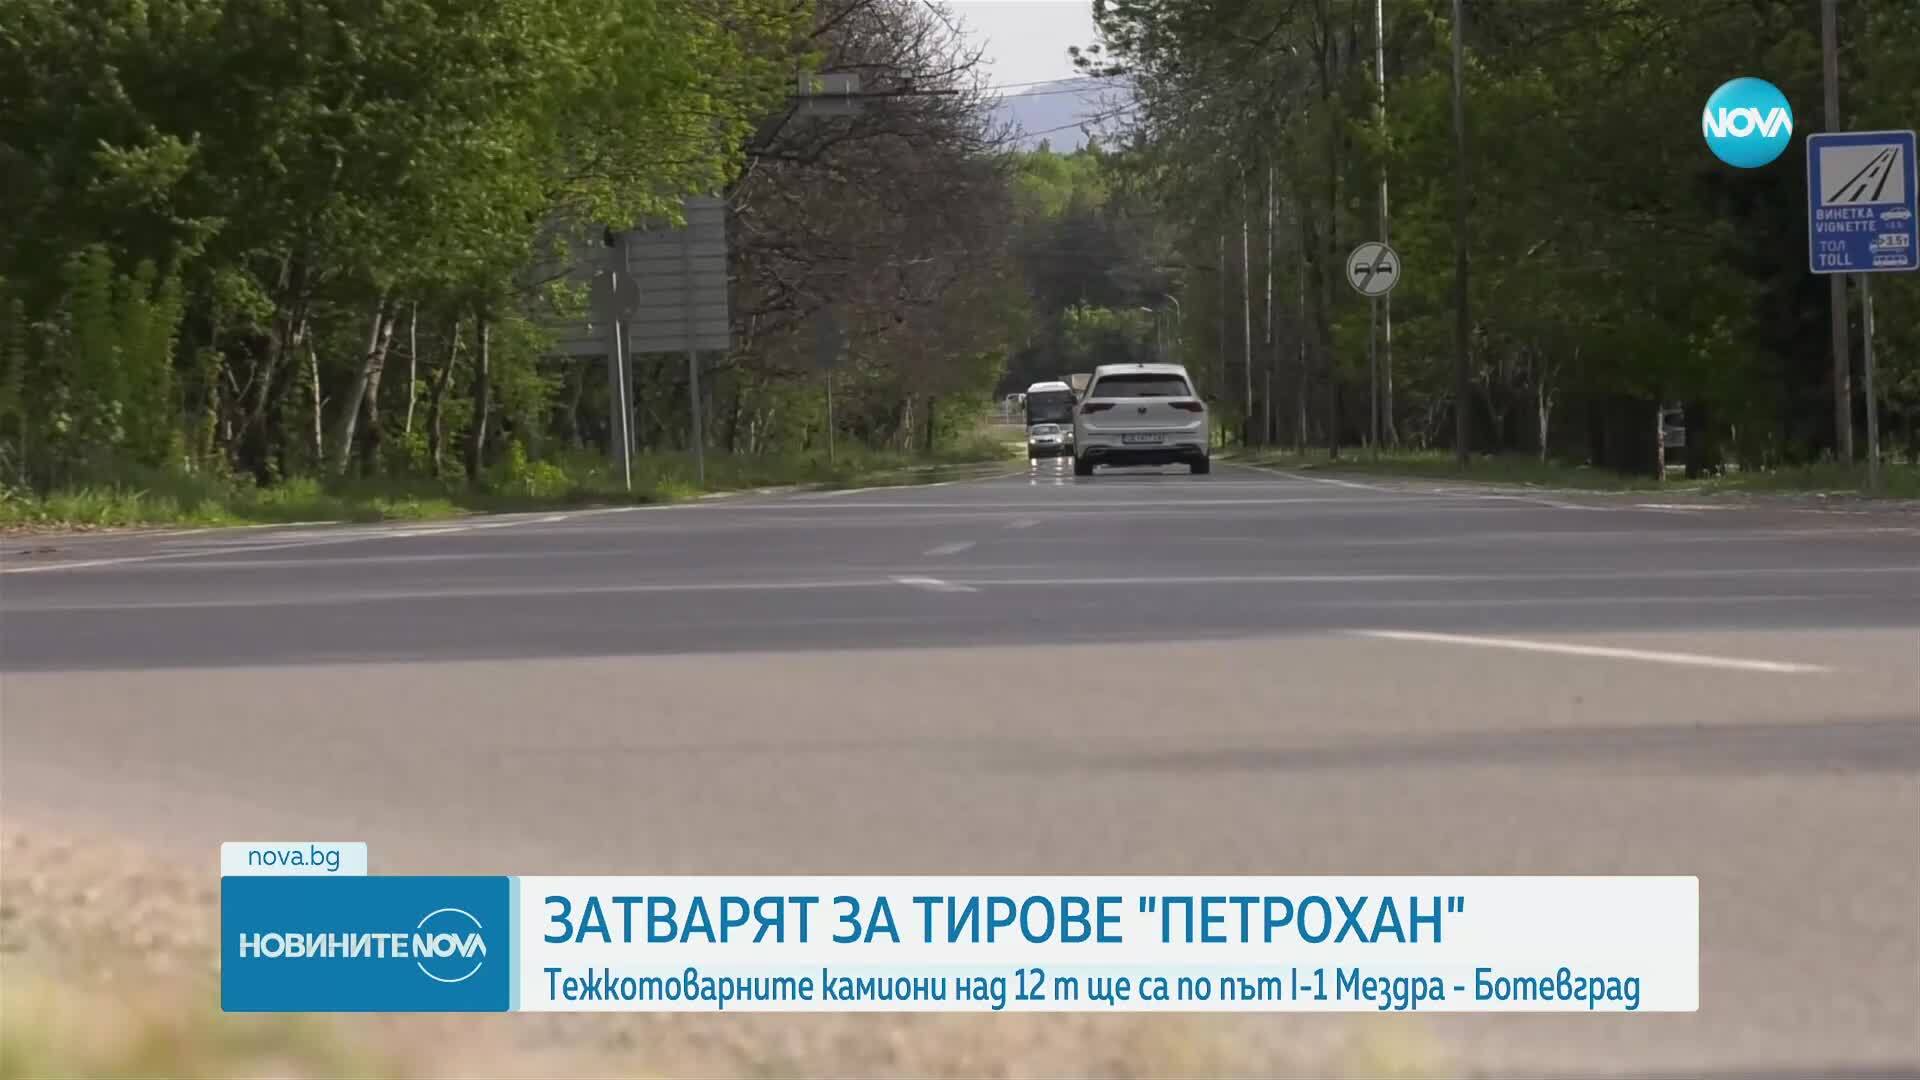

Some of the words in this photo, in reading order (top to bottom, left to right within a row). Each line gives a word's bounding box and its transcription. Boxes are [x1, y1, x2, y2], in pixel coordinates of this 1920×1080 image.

[1816, 208, 1874, 220] ВИНЕТКА
[1816, 220, 1877, 233] VIGNETTE
[1820, 240, 1846, 252] ТОЛ
[1820, 253, 1852, 266] TOLL
